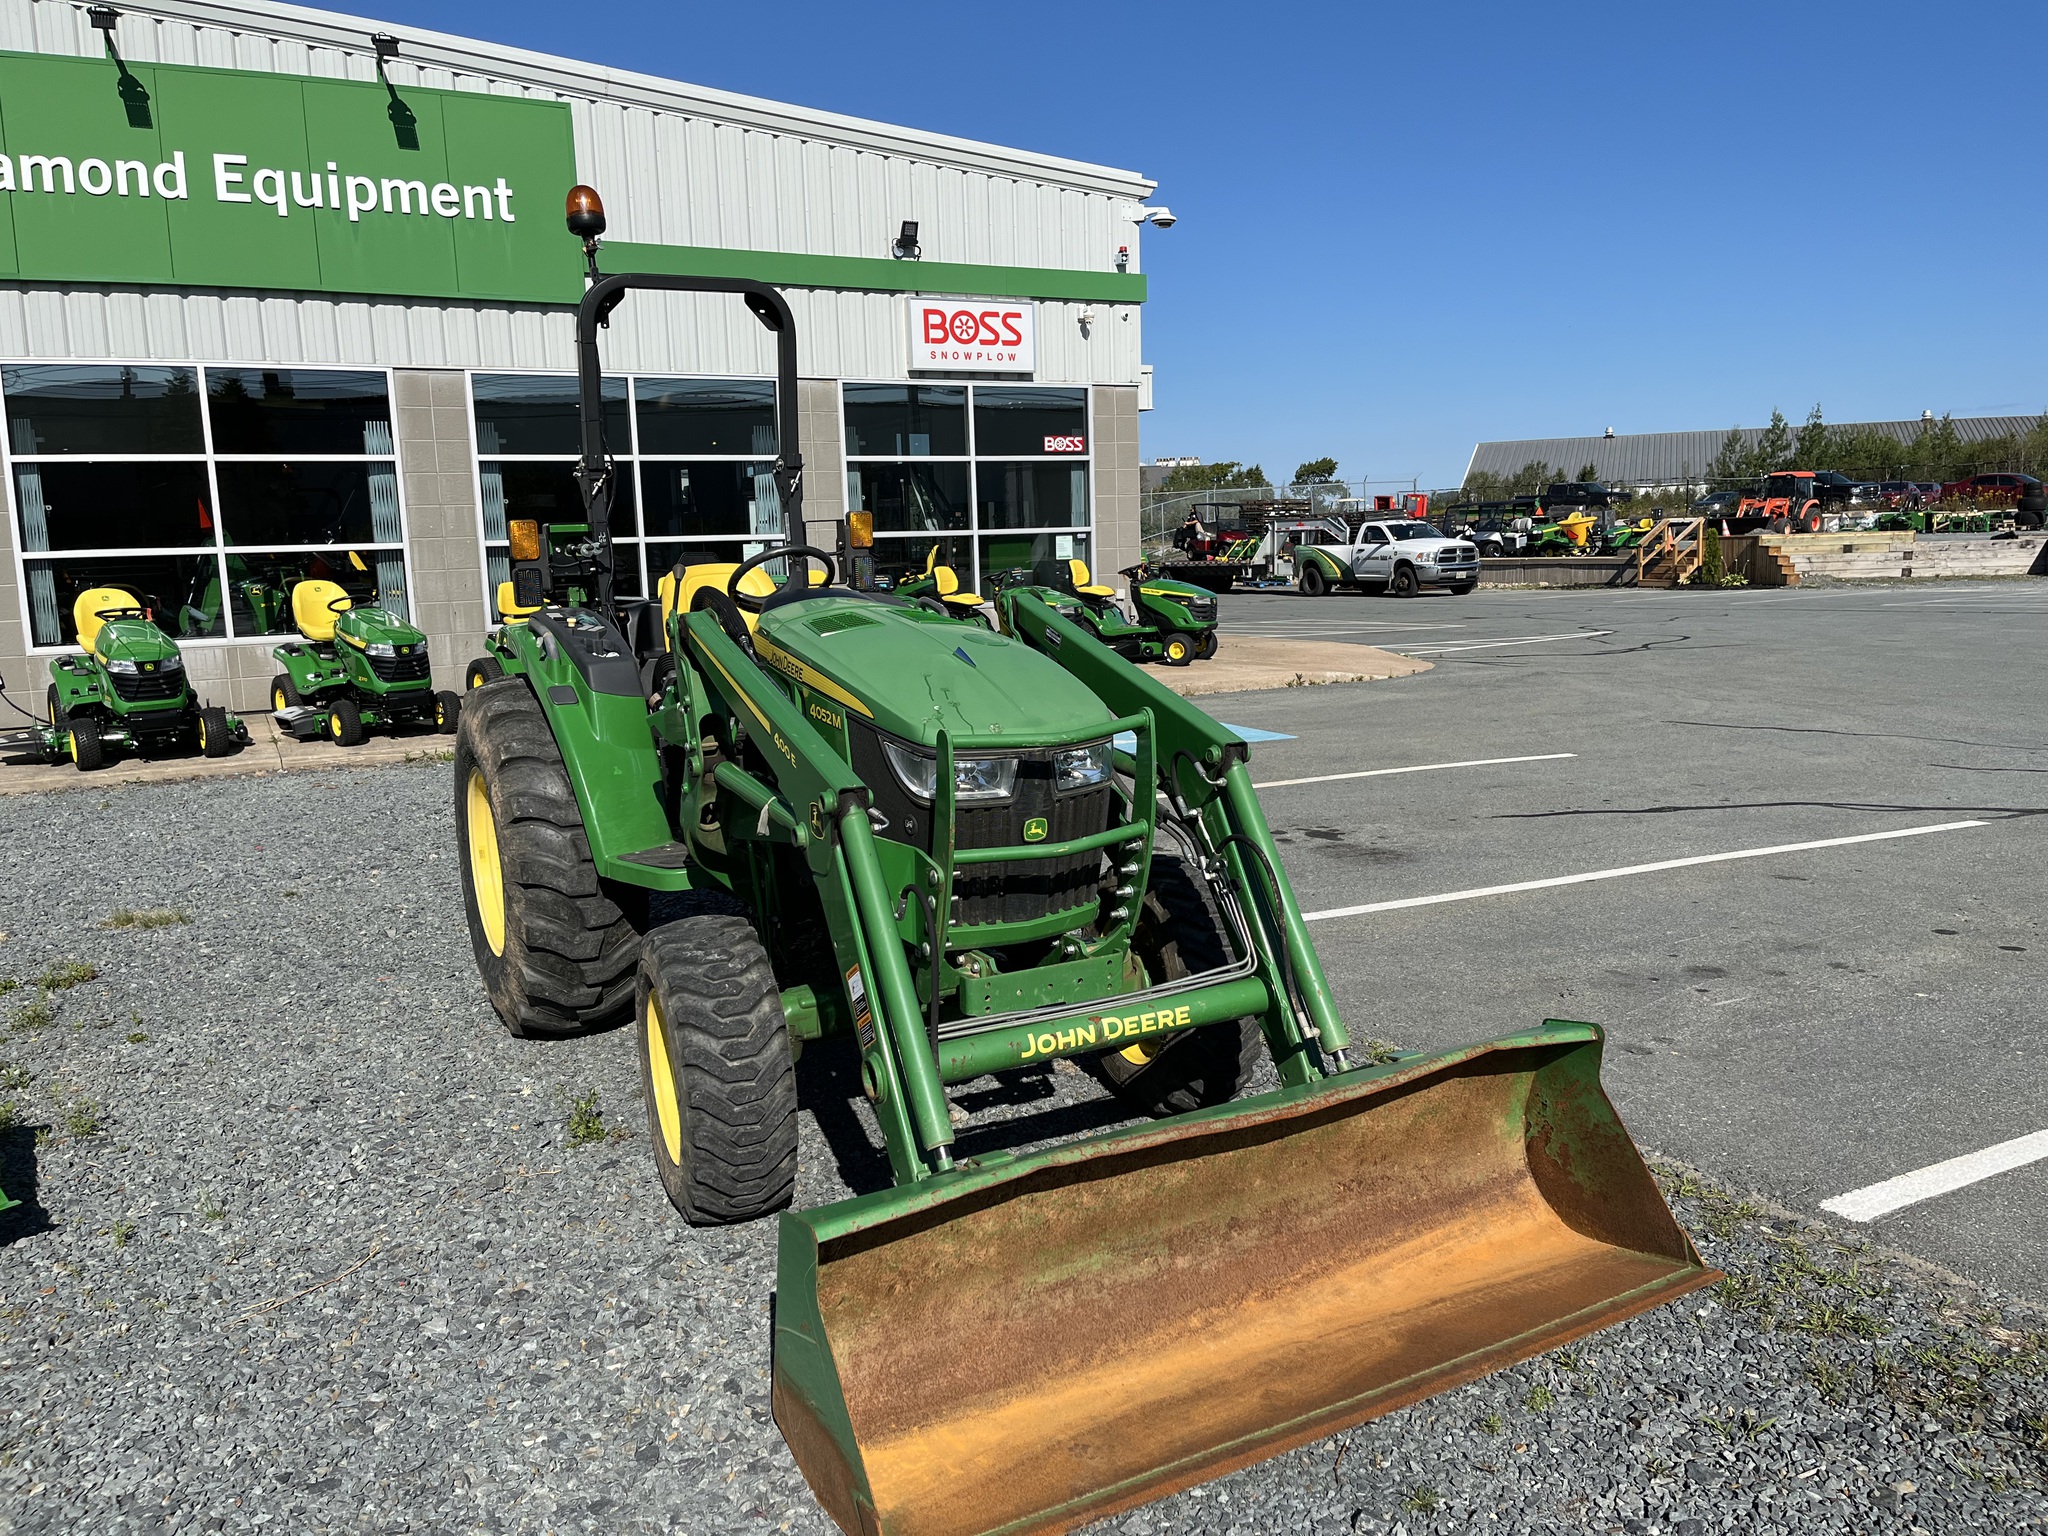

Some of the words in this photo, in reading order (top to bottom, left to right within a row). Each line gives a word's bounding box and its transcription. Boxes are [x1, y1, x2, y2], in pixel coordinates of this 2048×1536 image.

[0, 151, 188, 200] amond
[212, 153, 515, 222] Equipment
[923, 309, 1022, 346] BOSS
[930, 351, 1016, 361] SNOWPLOW
[1044, 437, 1083, 451] BOSS
[810, 704, 842, 730] 4052M
[1021, 1024, 1096, 1058] JOHN
[1101, 1005, 1191, 1040] DEERE
